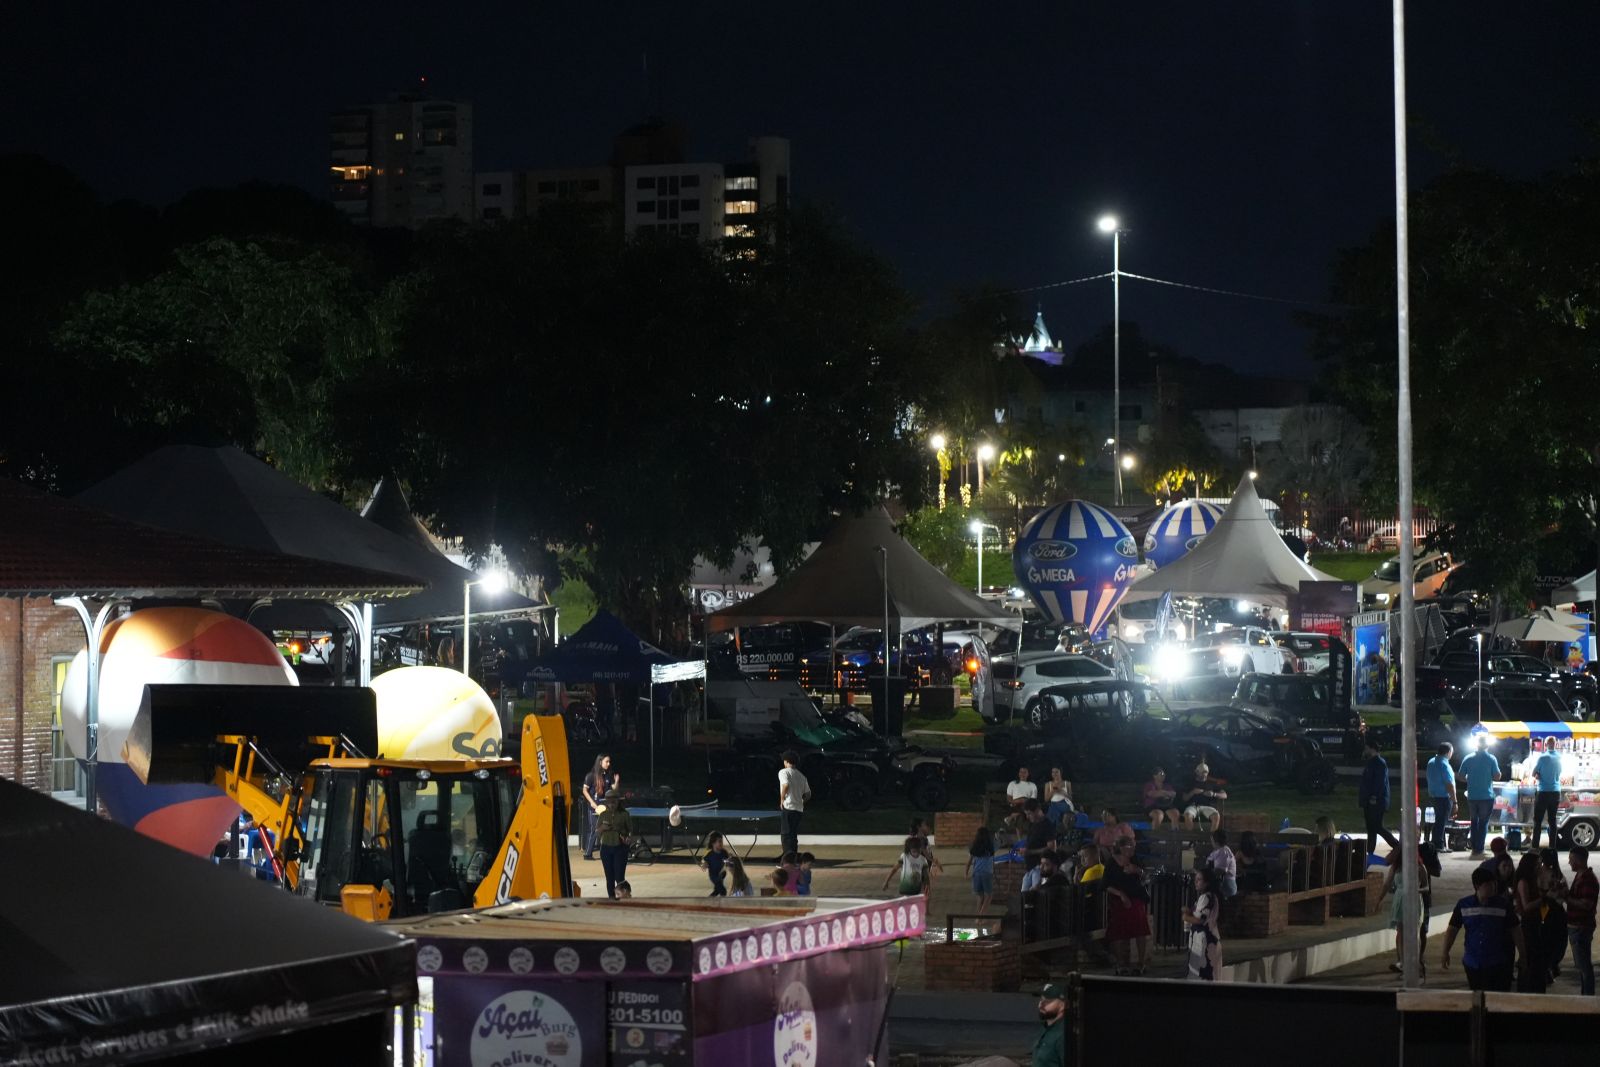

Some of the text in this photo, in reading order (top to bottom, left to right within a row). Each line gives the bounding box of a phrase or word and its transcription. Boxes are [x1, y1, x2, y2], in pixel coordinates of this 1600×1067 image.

[1035, 542, 1067, 559] Ford
[1040, 568, 1075, 582] MEGA
[749, 652, 794, 665] 220.000,00
[79, 1028, 169, 1059] Sorvetes
[175, 1022, 189, 1040] e
